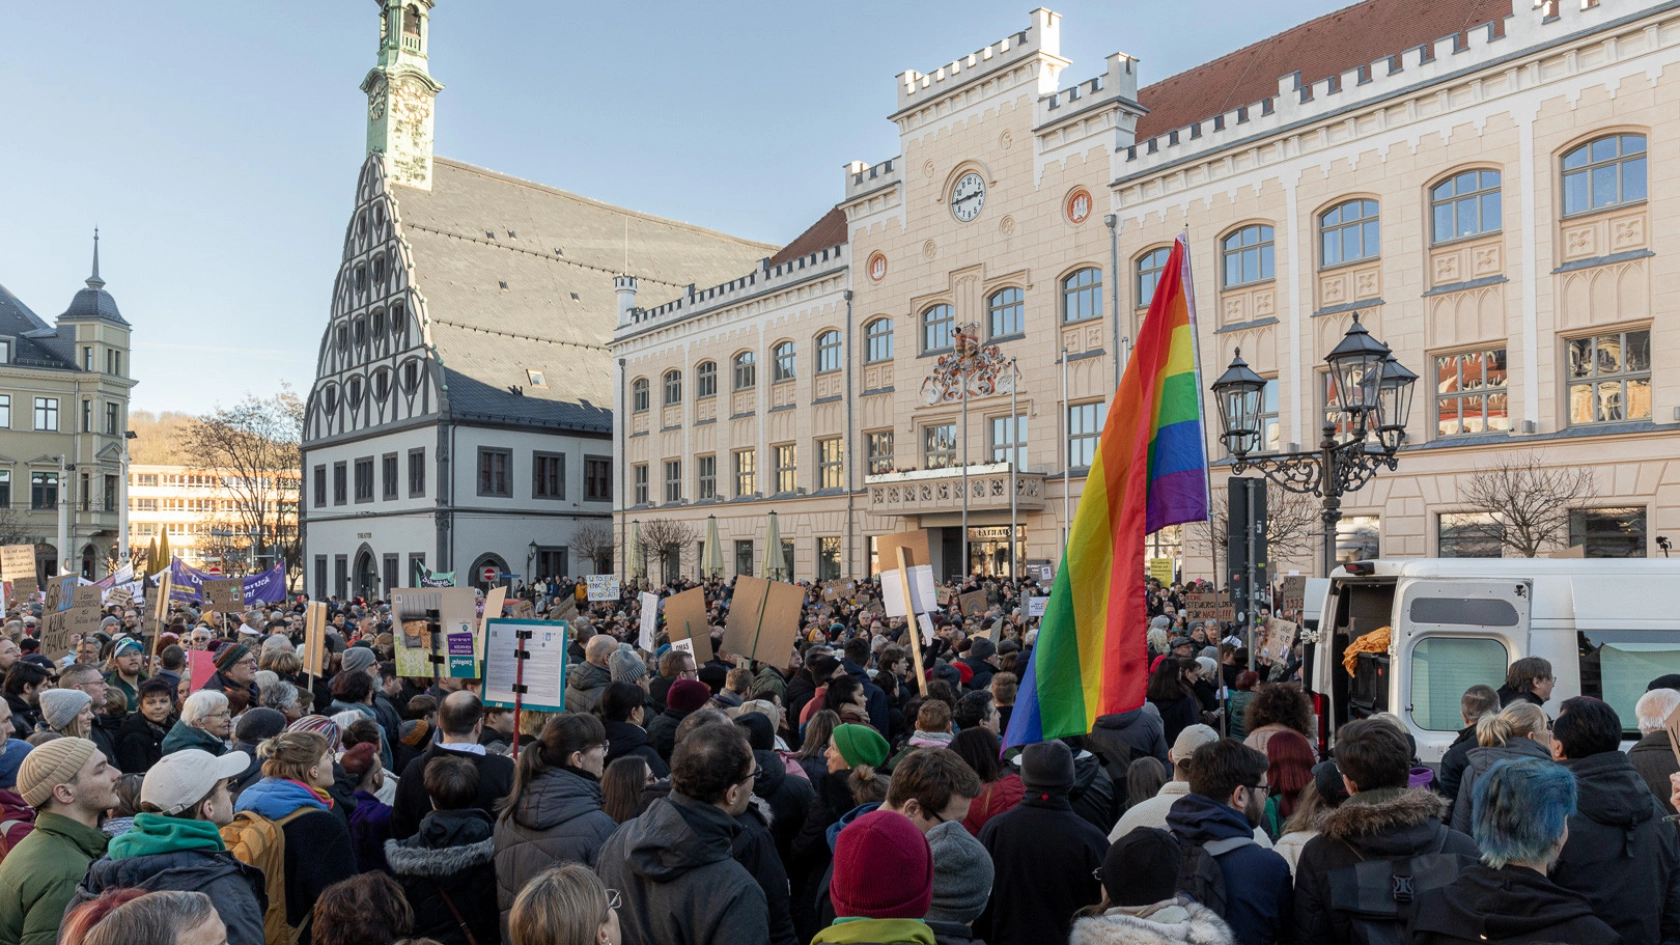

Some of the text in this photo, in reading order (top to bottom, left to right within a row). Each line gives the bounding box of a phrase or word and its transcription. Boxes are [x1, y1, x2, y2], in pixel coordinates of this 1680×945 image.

[976, 529, 1011, 537] RATHAUS
[1286, 598, 1304, 609] 1933
[1188, 610, 1201, 619] FÜR
